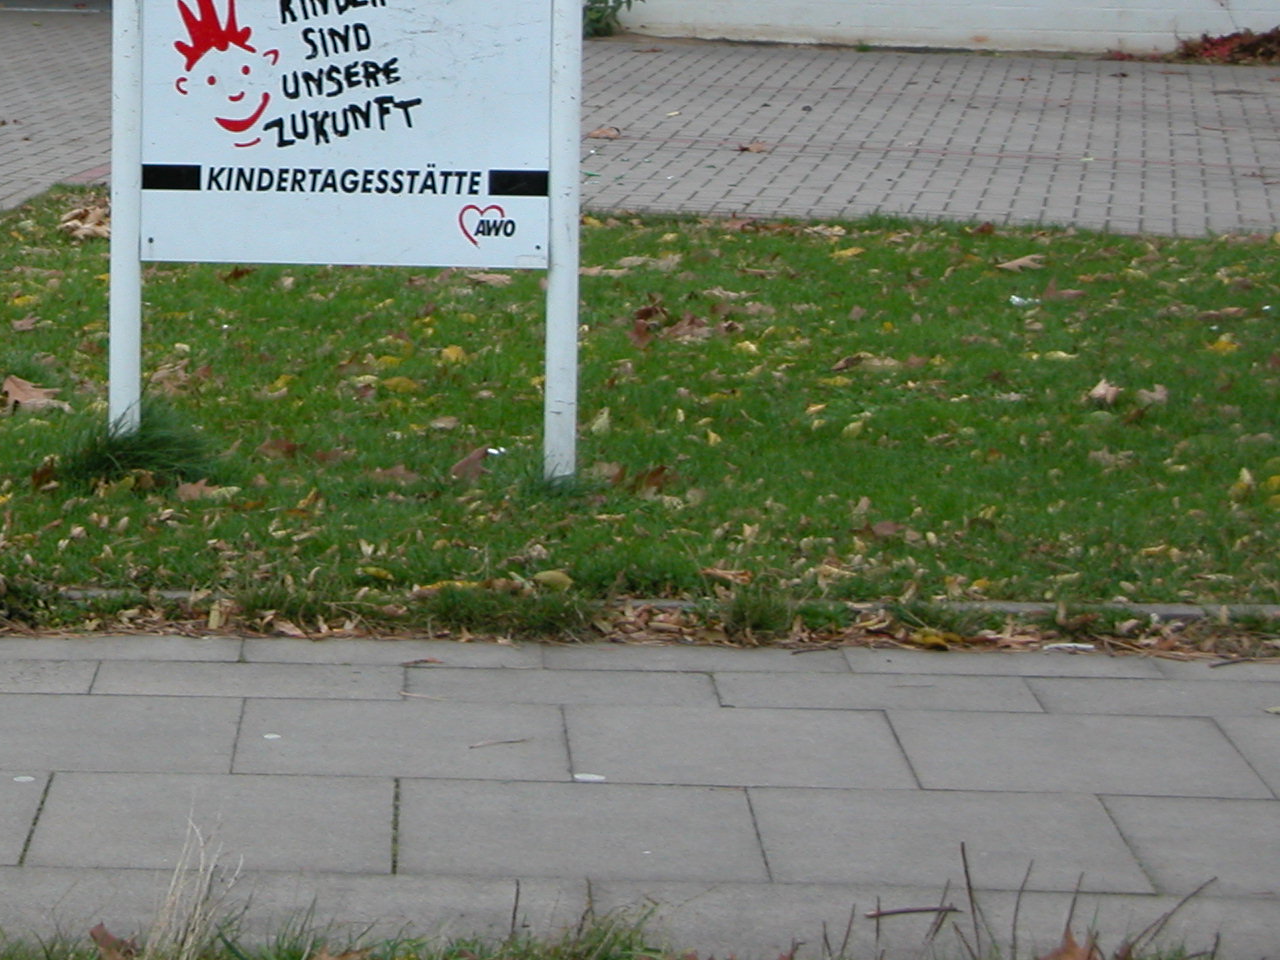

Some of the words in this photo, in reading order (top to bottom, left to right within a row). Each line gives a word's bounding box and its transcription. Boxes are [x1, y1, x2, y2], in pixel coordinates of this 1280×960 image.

[302, 23, 371, 60] SIND
[282, 57, 401, 100] UNSERE
[263, 96, 422, 148] ZUKUNFT
[206, 164, 482, 195] KINDERTAGESSTÄTTE
[474, 219, 516, 238] AWO
